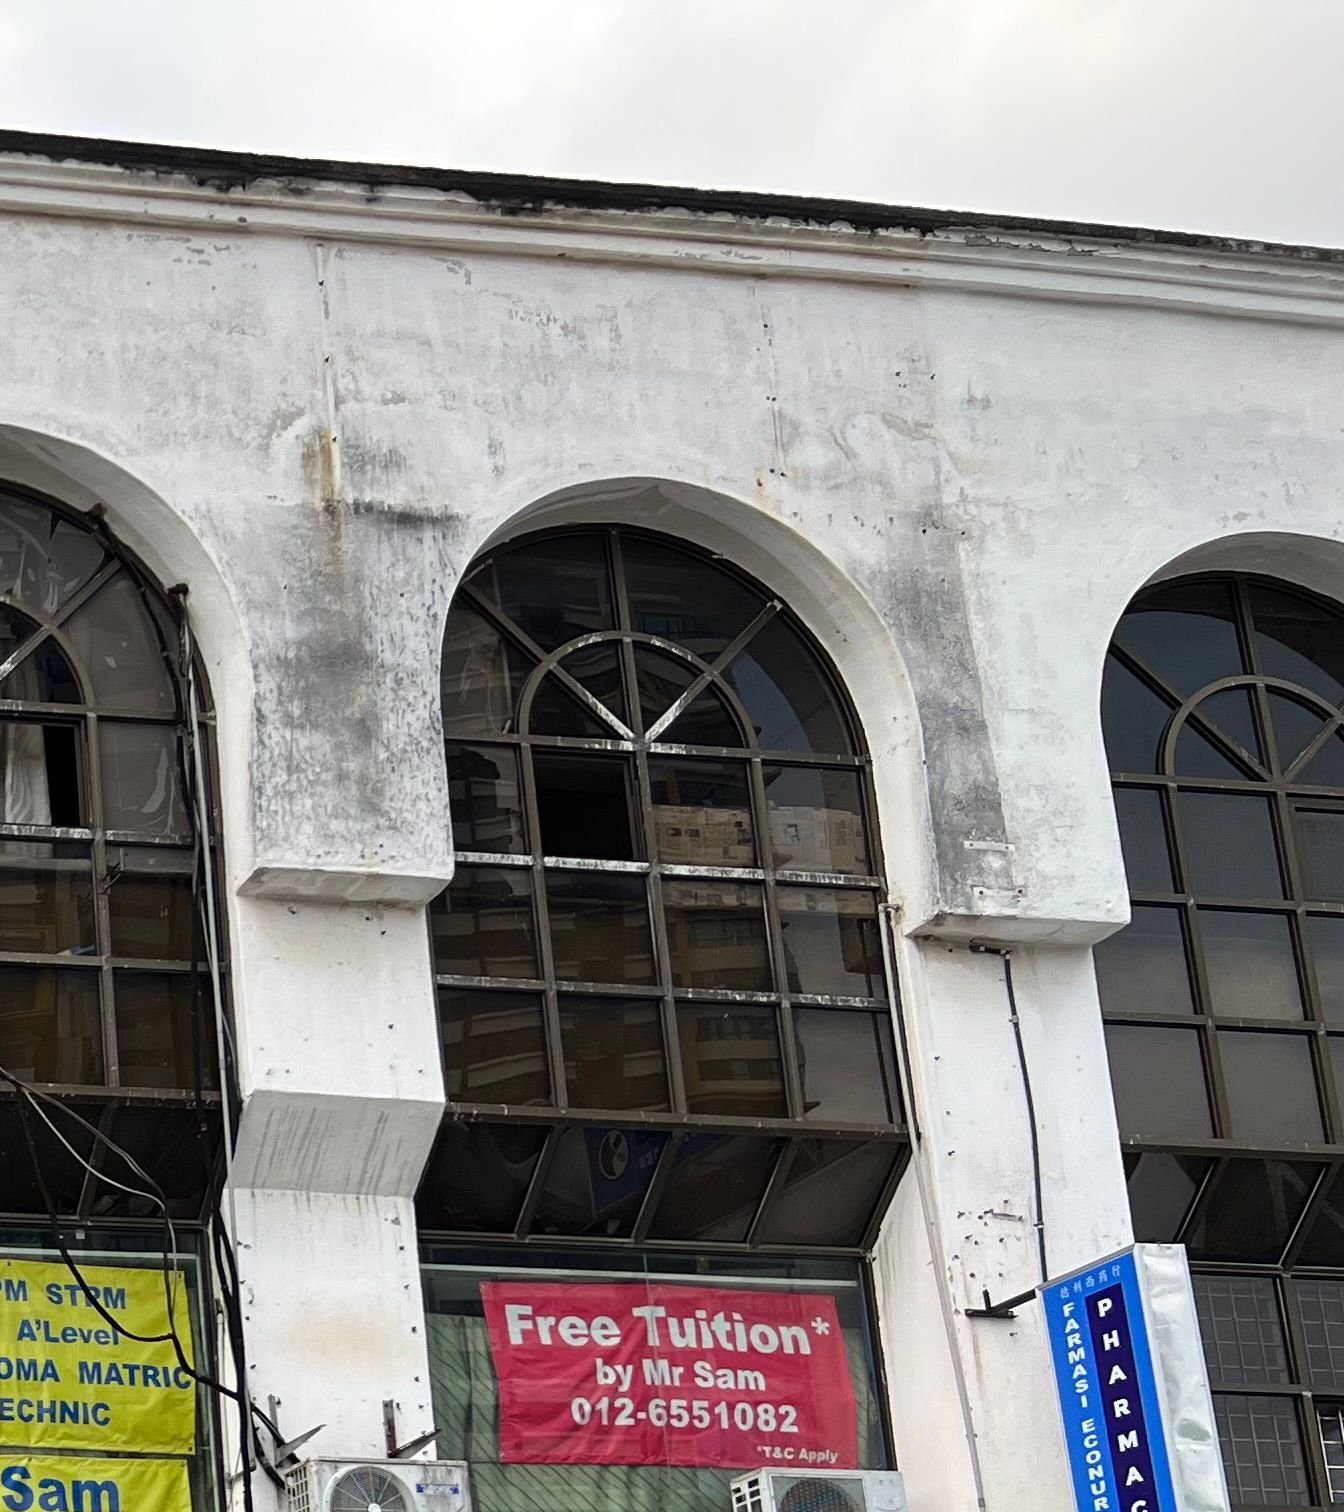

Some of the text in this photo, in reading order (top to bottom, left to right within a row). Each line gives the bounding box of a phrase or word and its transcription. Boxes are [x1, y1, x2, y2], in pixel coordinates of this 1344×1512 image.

[504, 1304, 622, 1347] Free
[1062, 1301, 1088, 1409] FARMASI
[78, 1361, 192, 1390] MATRIC
[596, 1358, 766, 1393] by Mr Sam
[571, 1397, 799, 1433] 012-6551082
[798, 1449, 839, 1465] Apply
